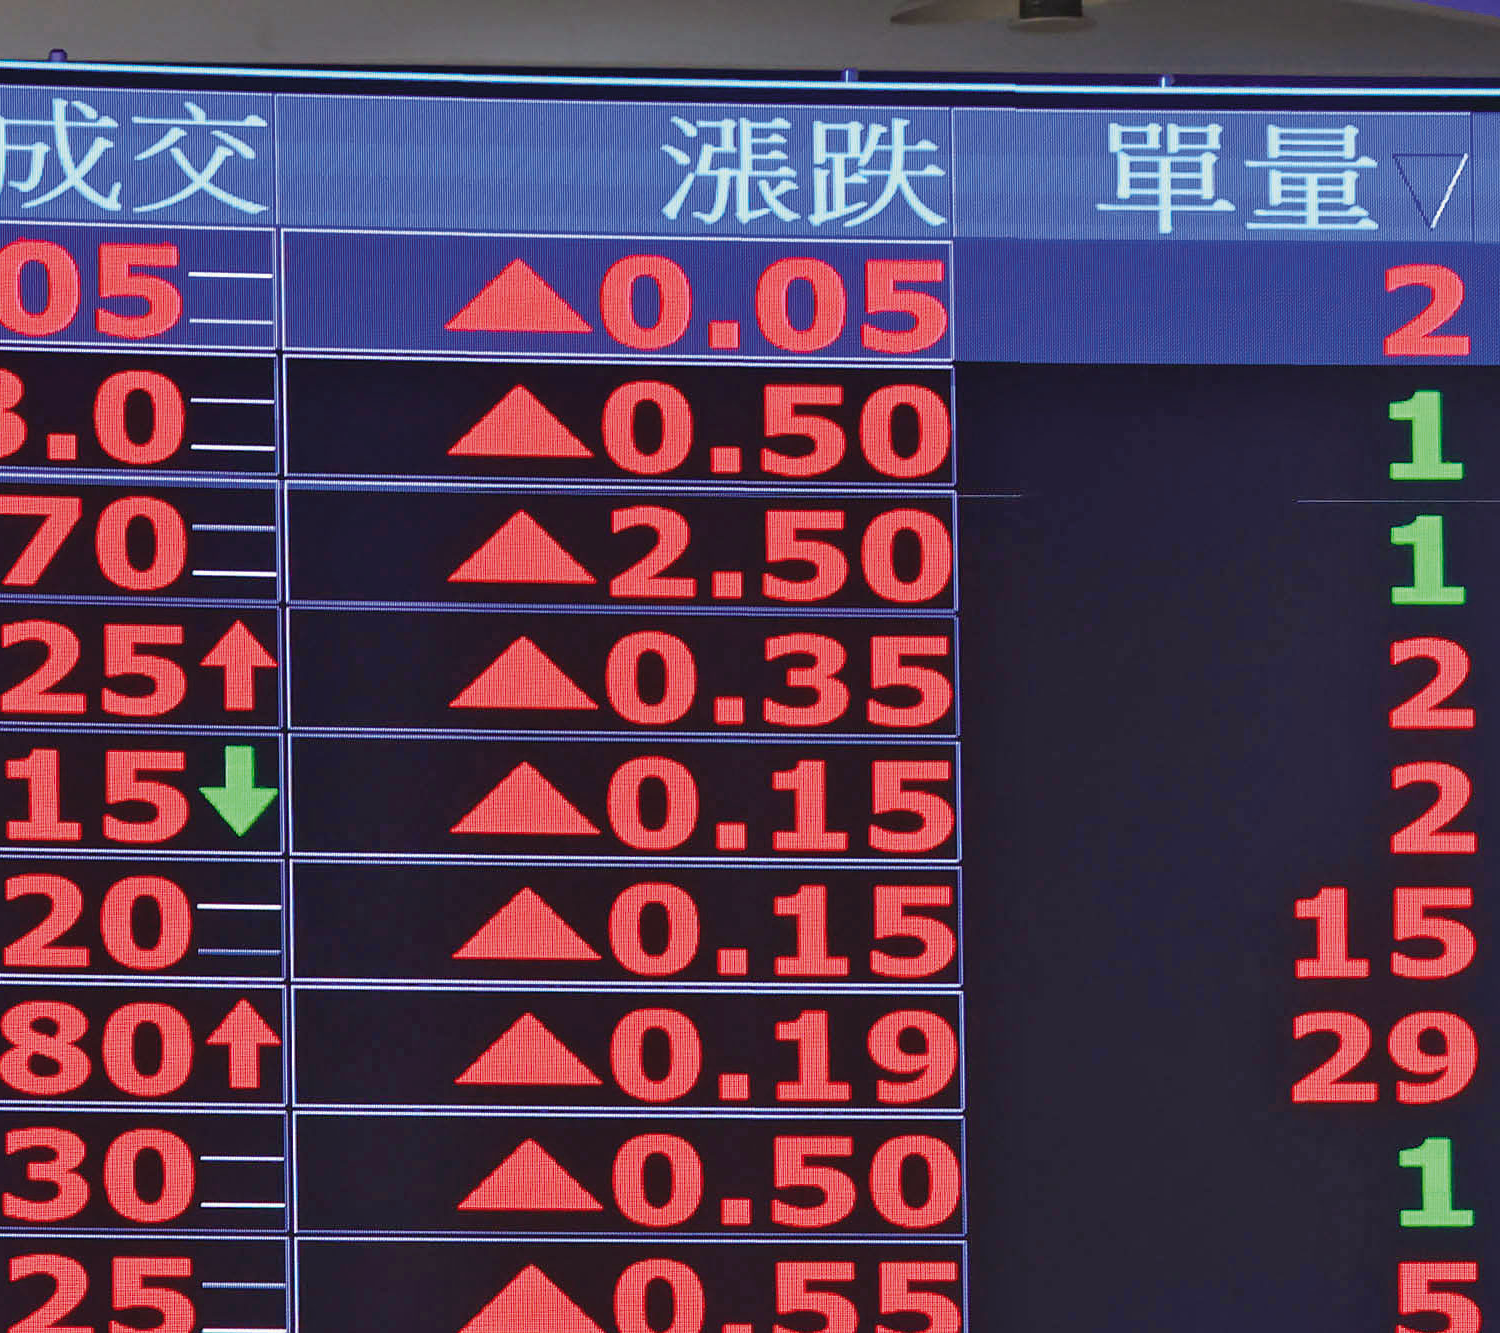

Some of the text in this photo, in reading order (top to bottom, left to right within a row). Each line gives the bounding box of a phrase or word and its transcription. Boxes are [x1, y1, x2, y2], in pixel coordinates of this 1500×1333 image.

[660, 112, 948, 230] 漲跌
[1096, 122, 1380, 234] 單量
[599, 253, 949, 355] 0.05
[1382, 263, 1472, 358] 2
[604, 630, 954, 728] 0.35
[1388, 636, 1477, 730] 2
[608, 881, 957, 979] 0.15
[1294, 886, 1477, 980] 15
[609, 1007, 958, 1105] 0.19
[1291, 1010, 1479, 1105] 29
